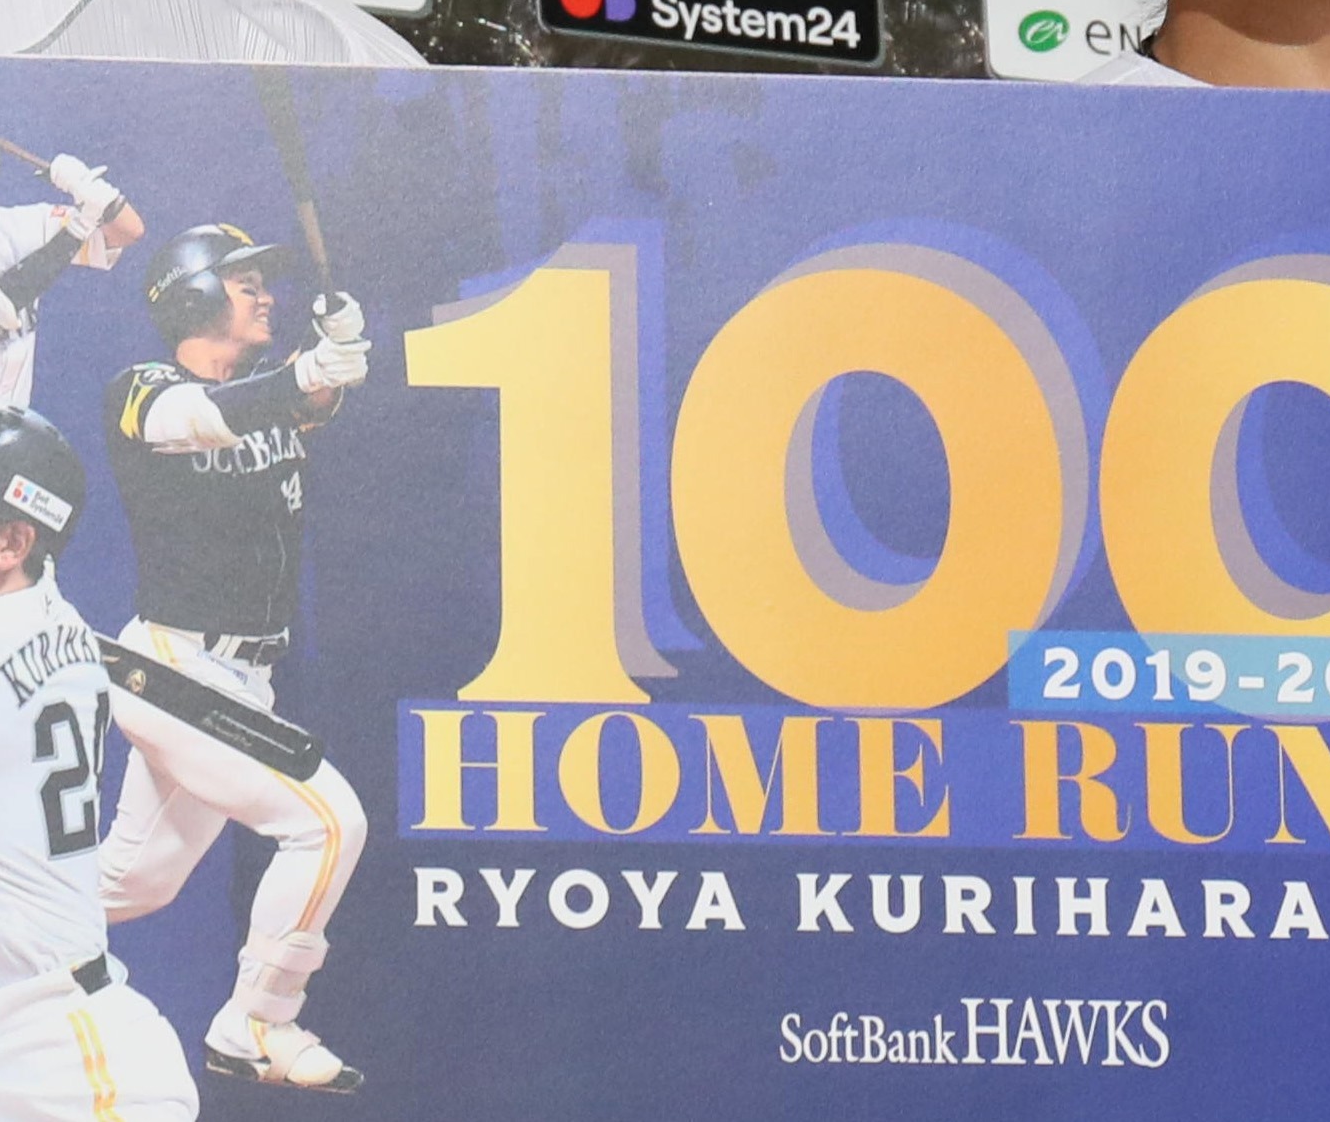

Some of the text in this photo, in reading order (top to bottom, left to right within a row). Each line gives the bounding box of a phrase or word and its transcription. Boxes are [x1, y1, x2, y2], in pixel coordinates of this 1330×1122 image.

[409, 707, 951, 838] HOME
[413, 867, 746, 931] RYOYA
[796, 871, 1330, 940] KURIHARA
